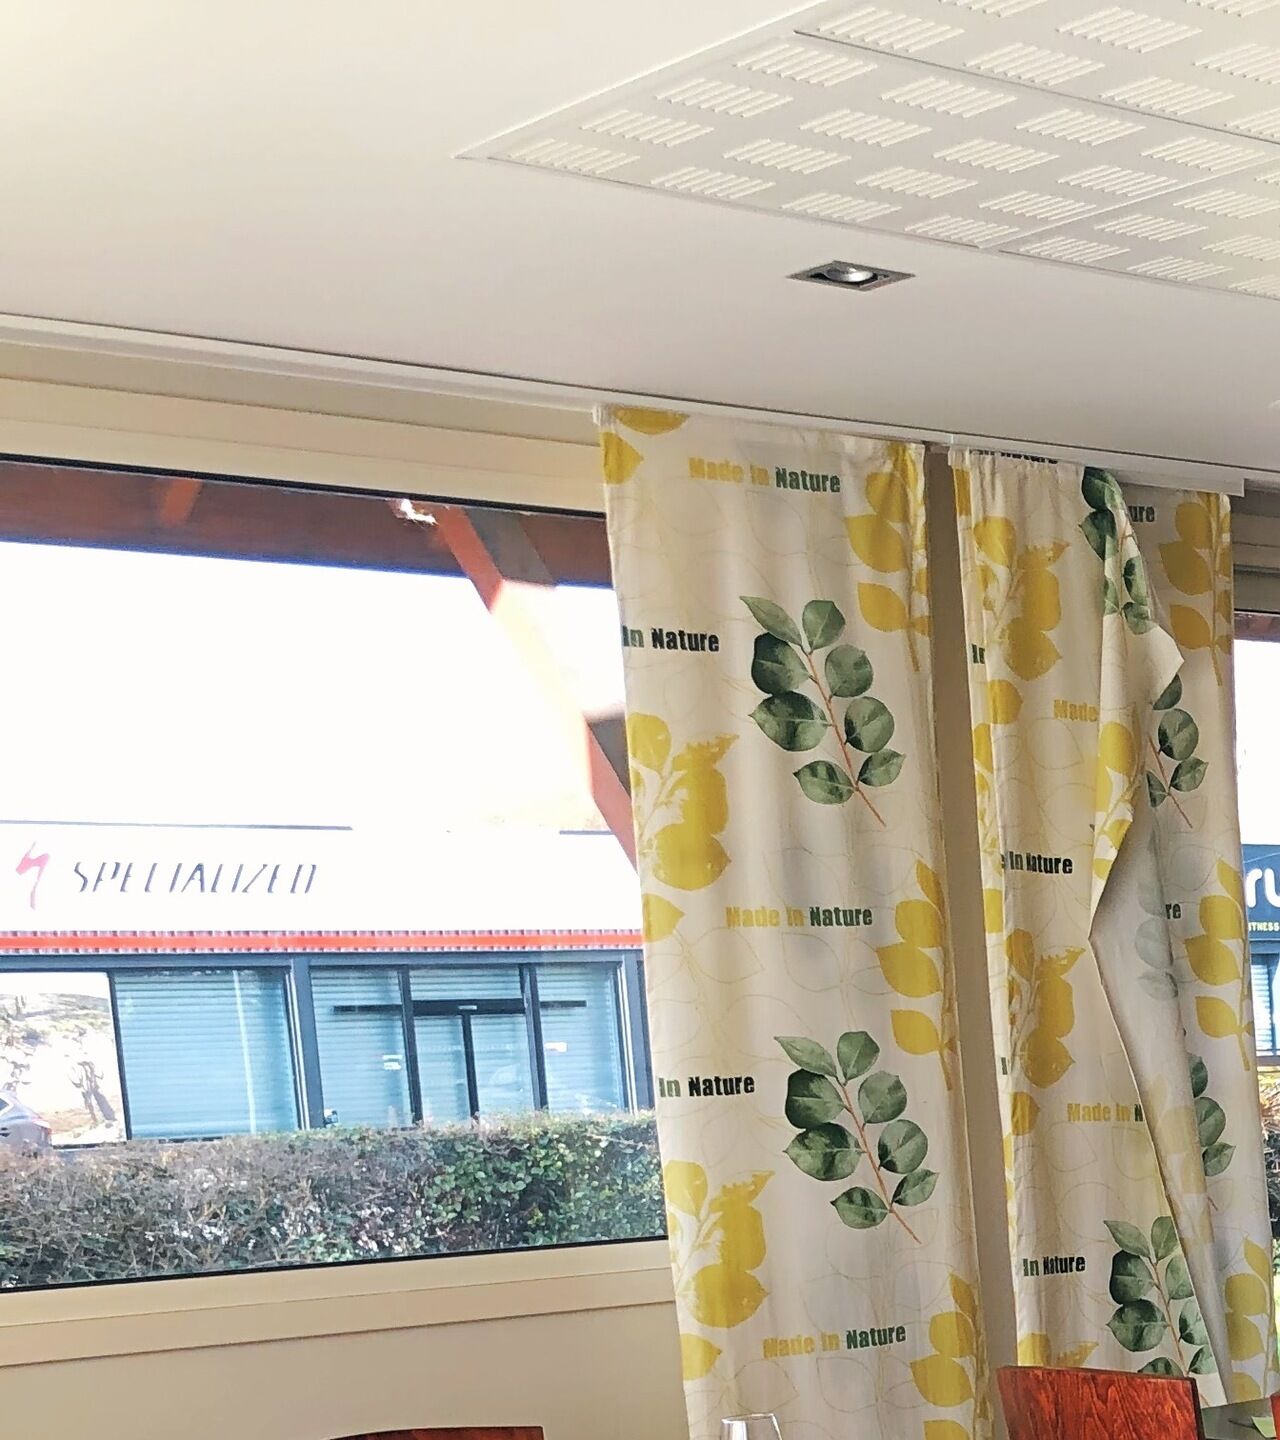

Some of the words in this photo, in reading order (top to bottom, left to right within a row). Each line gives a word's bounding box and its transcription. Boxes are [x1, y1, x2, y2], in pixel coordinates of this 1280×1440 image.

[688, 457, 743, 484] Made
[750, 464, 769, 486] In
[775, 466, 841, 493] Nature
[622, 625, 644, 648] In
[651, 627, 719, 652] Nature
[1053, 699, 1099, 722] Made
[1009, 851, 1023, 871] In
[725, 906, 780, 929] Made
[786, 906, 804, 927] In
[810, 906, 873, 927] Nature
[658, 1077, 680, 1098] In
[688, 1076, 755, 1097] Nature
[1067, 1103, 1112, 1122] Made
[1115, 1103, 1131, 1122] In
[1023, 1258, 1039, 1277] In
[1043, 1256, 1086, 1276] Nature
[763, 1334, 815, 1359] Made
[820, 1331, 840, 1351] In
[846, 1325, 906, 1350] Nature
